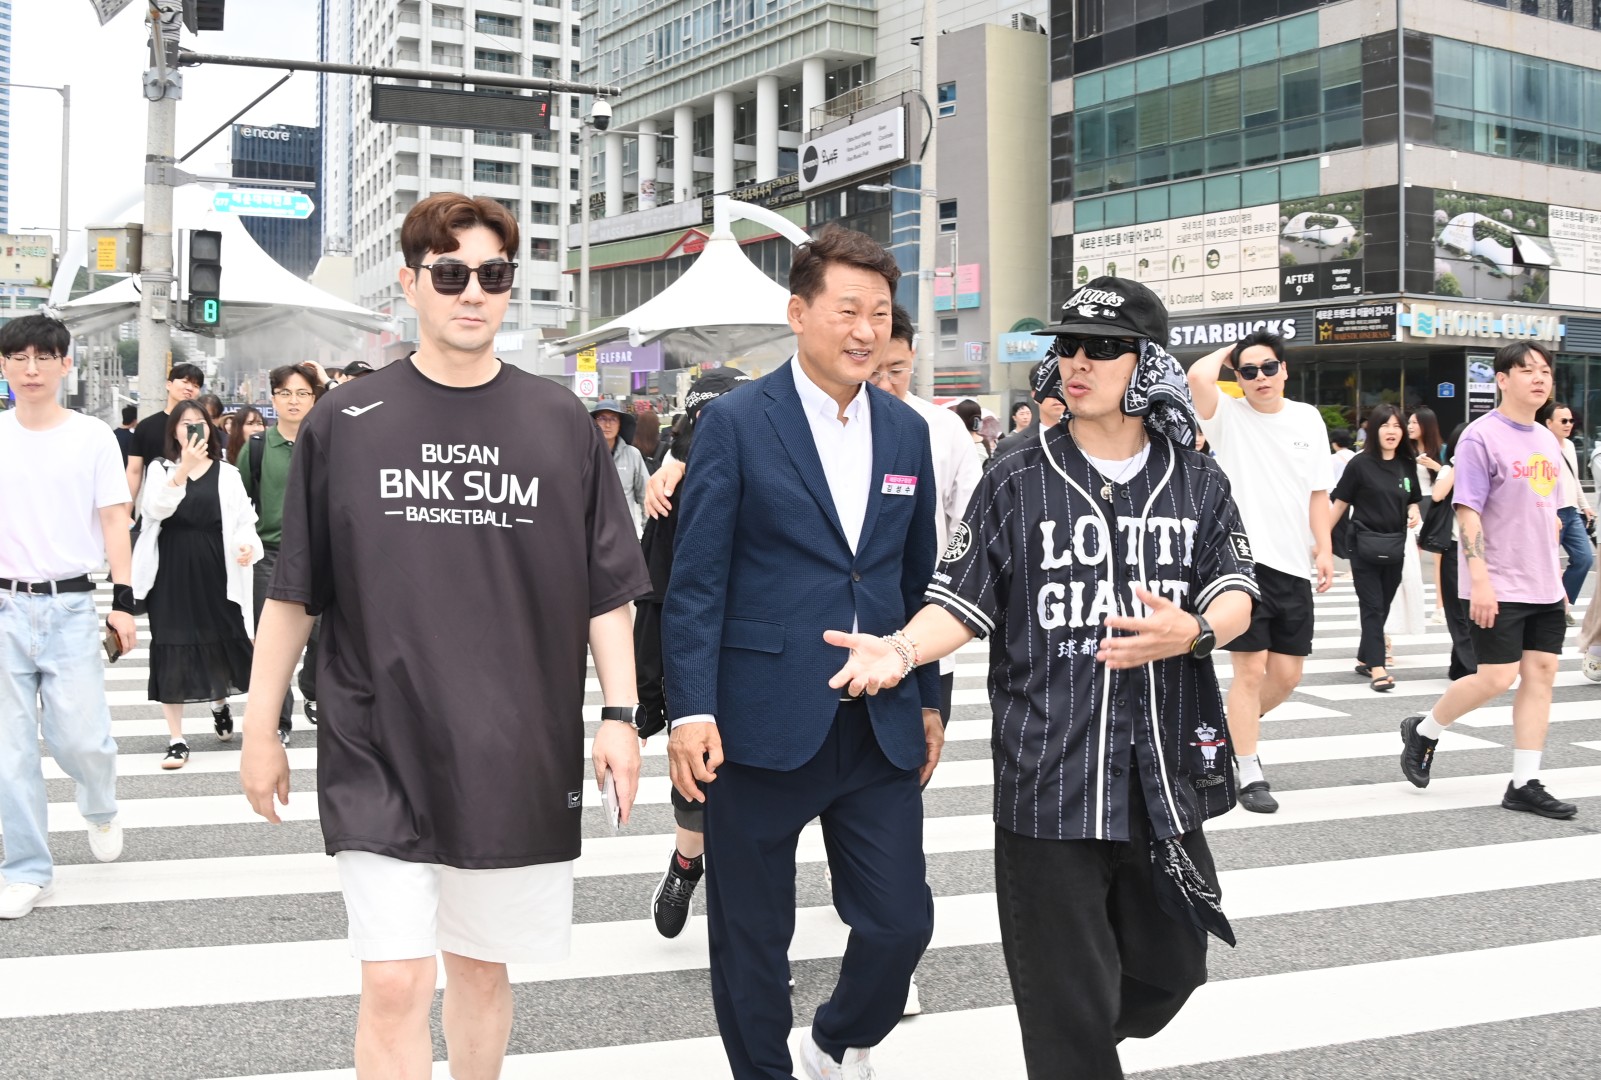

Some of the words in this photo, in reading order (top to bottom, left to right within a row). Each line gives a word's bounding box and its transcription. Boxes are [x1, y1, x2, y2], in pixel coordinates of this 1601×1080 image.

[241, 127, 290, 141] encore
[1080, 237, 1096, 249] 새로운
[1097, 232, 1122, 247] 트렌드를
[1284, 273, 1315, 285] AFTER
[1175, 292, 1203, 304] Curated
[1211, 291, 1234, 302] Space
[1242, 285, 1277, 298] PLATFORM
[1295, 285, 1303, 296] 9
[204, 300, 217, 322] 8
[1170, 318, 1296, 346] STARBUCKS
[1437, 308, 1501, 338] HOTEL
[600, 350, 632, 364] ELFBAR
[421, 443, 499, 466] BUSAN
[1512, 460, 1539, 481] Surf
[380, 468, 455, 501] BNK
[463, 470, 539, 508] SUM
[406, 506, 512, 528] BASKETBALL
